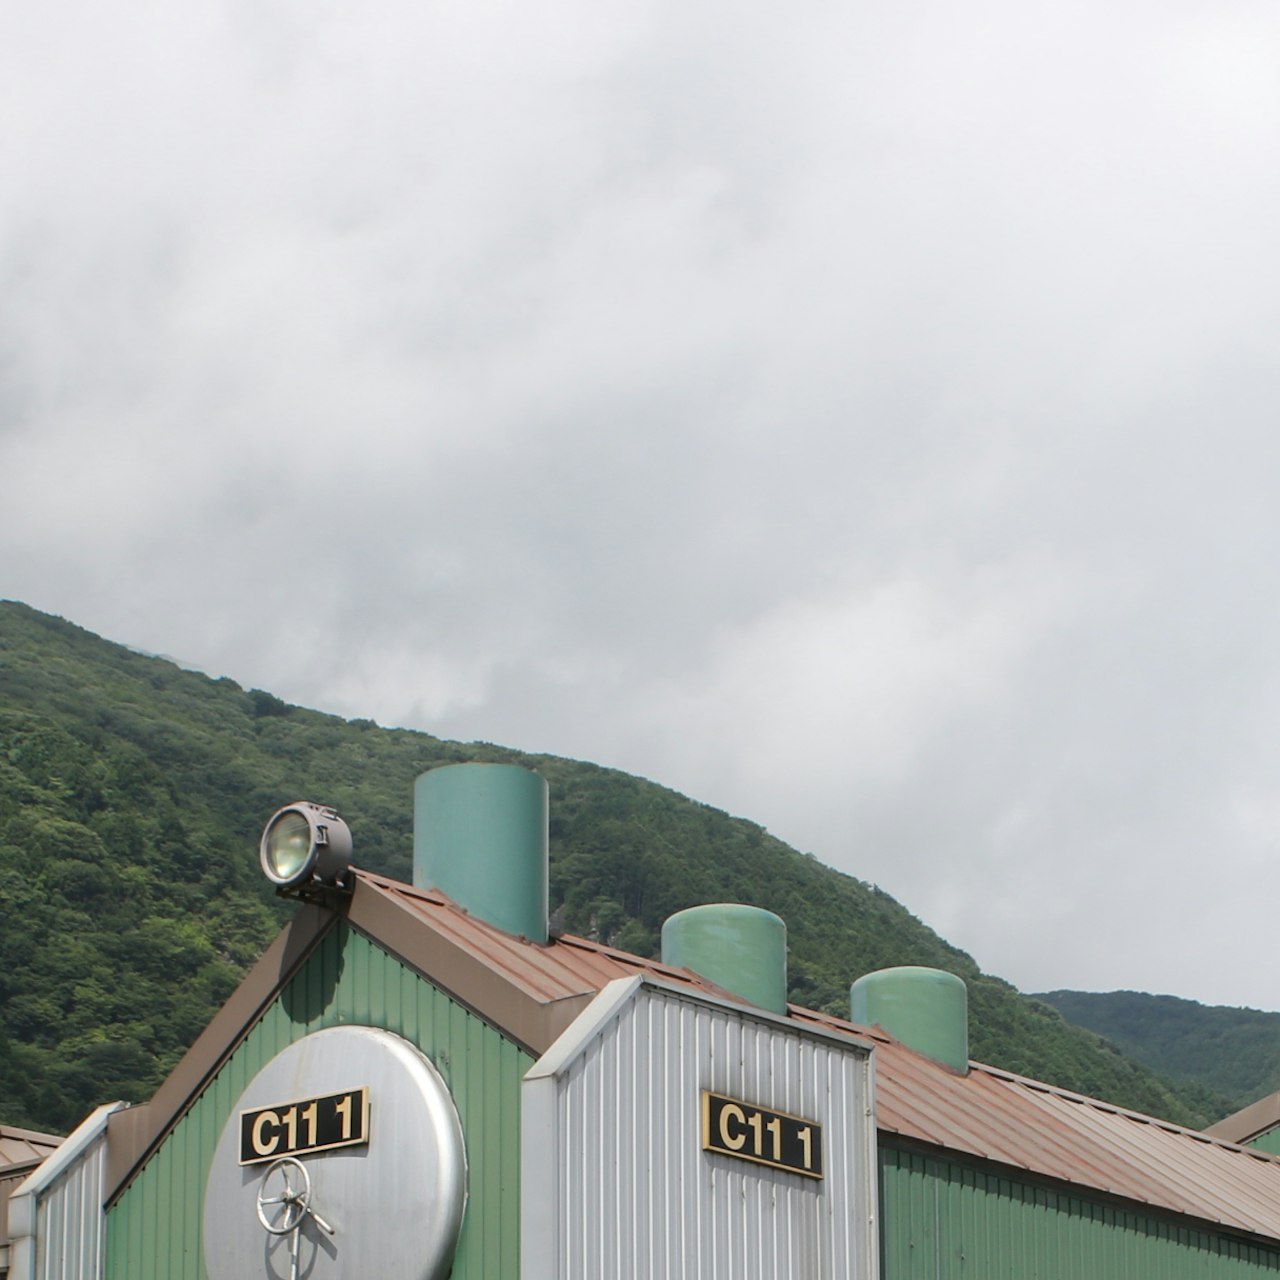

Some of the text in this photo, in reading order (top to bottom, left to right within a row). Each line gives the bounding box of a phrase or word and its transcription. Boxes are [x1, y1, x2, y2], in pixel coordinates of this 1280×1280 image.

[251, 1093, 353, 1156] C11 1
[718, 1103, 813, 1168] C11 1
